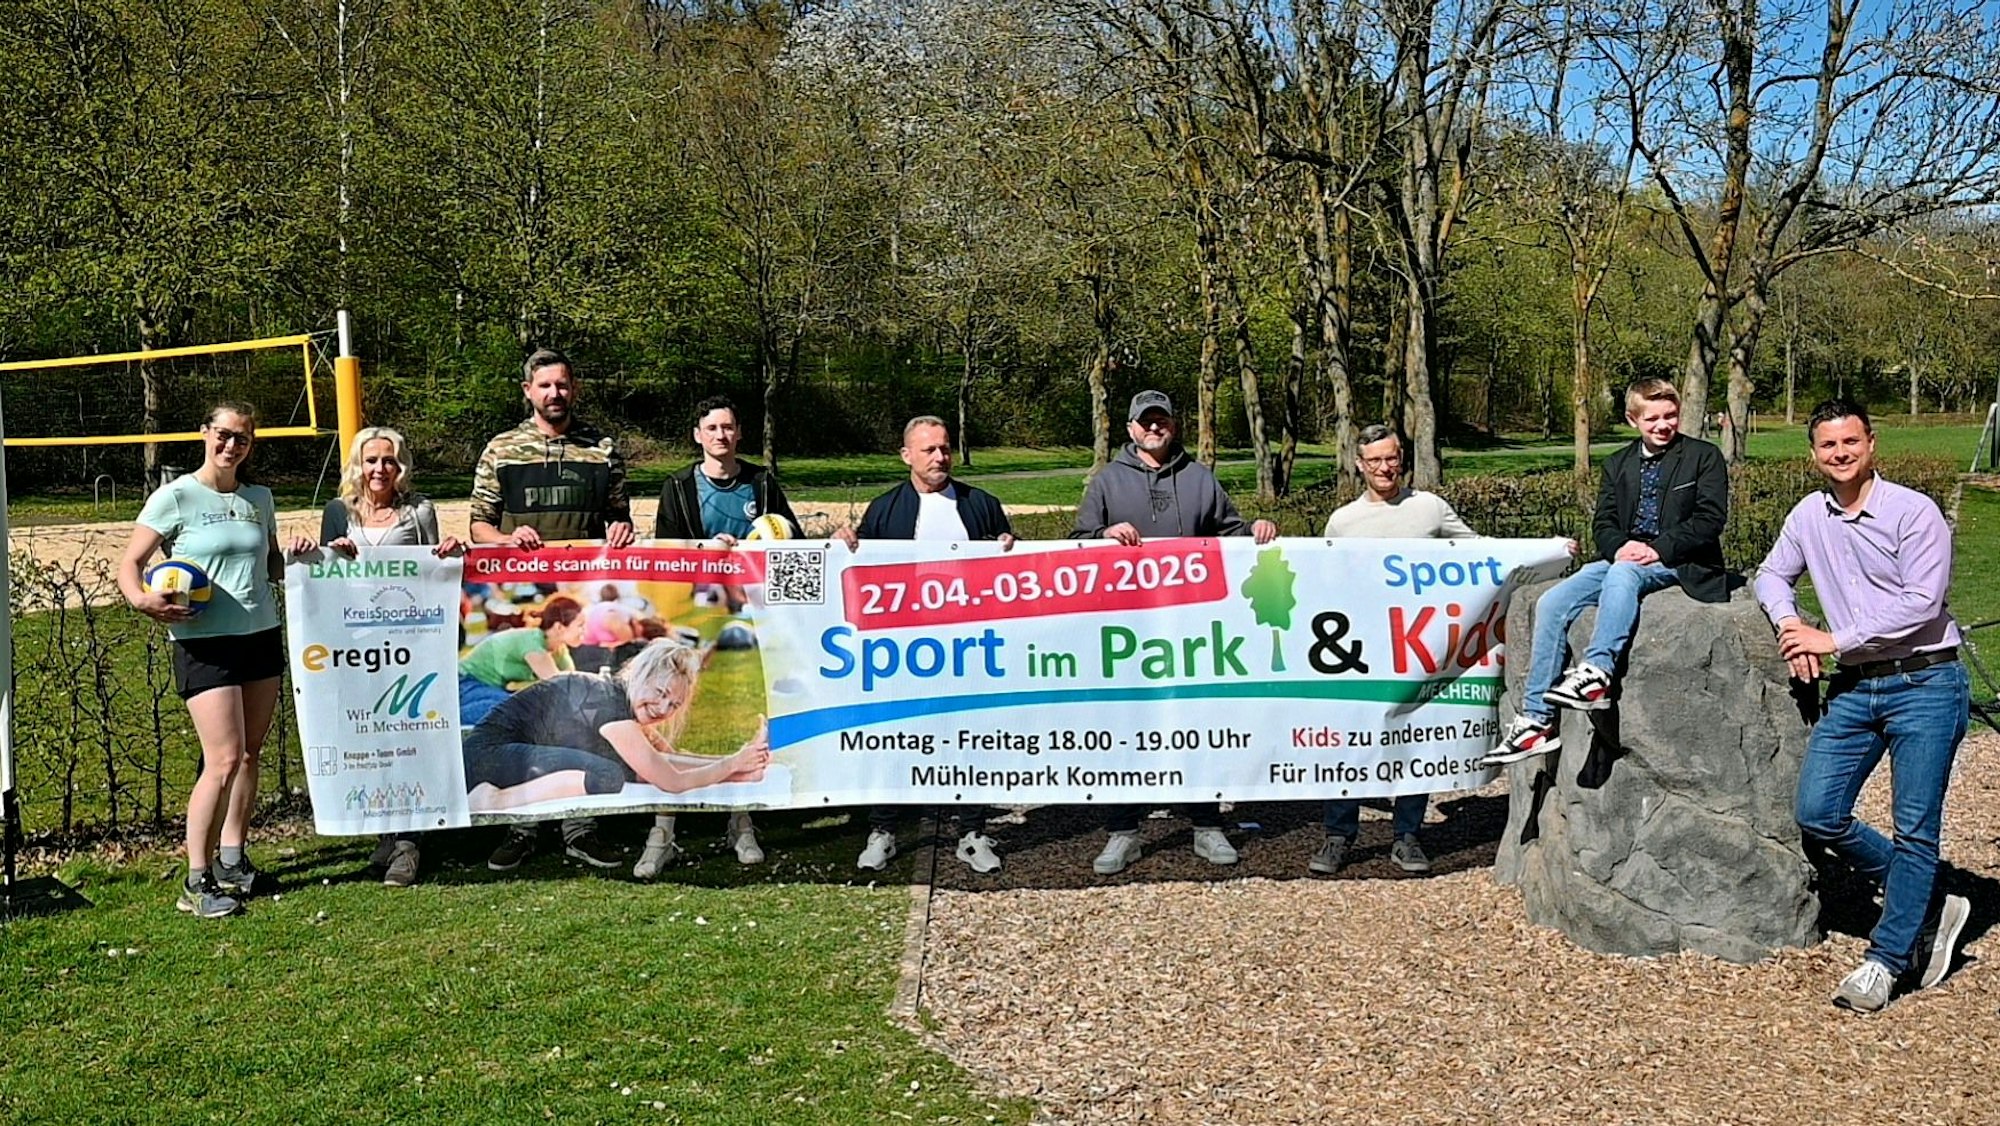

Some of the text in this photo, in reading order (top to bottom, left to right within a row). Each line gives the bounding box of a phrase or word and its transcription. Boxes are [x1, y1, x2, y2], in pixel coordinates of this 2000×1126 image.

[309, 560, 419, 579] BARMER
[476, 555, 746, 574] QR Code scannen für mehr Infos.
[1383, 554, 1503, 595] Sport
[860, 552, 1209, 615] 27.04.-03.07.2026
[343, 604, 441, 621] KreisSportBund
[302, 641, 411, 673] eregio
[819, 625, 1006, 692] Sport
[1027, 643, 1077, 678] im
[1101, 620, 1248, 680] Park
[1308, 611, 1369, 675] &
[1417, 682, 1503, 701] MECHERNIC
[347, 709, 371, 721] Wir
[356, 716, 450, 734] in Mechernich
[840, 730, 935, 754] Montag
[958, 729, 1040, 754] Freitag
[1049, 730, 1112, 751] 18.00
[1136, 730, 1199, 751] 19.00
[1208, 728, 1251, 749] Uhr
[1292, 727, 1340, 748] Kids
[1348, 729, 1372, 747] zu
[1380, 723, 1457, 747] anderen
[911, 765, 1183, 790] Mühlenpark Kommern
[1270, 763, 1306, 783] Für
[1315, 761, 1368, 783] Infos
[1376, 760, 1404, 781] QR
[1410, 754, 1459, 778] Code
